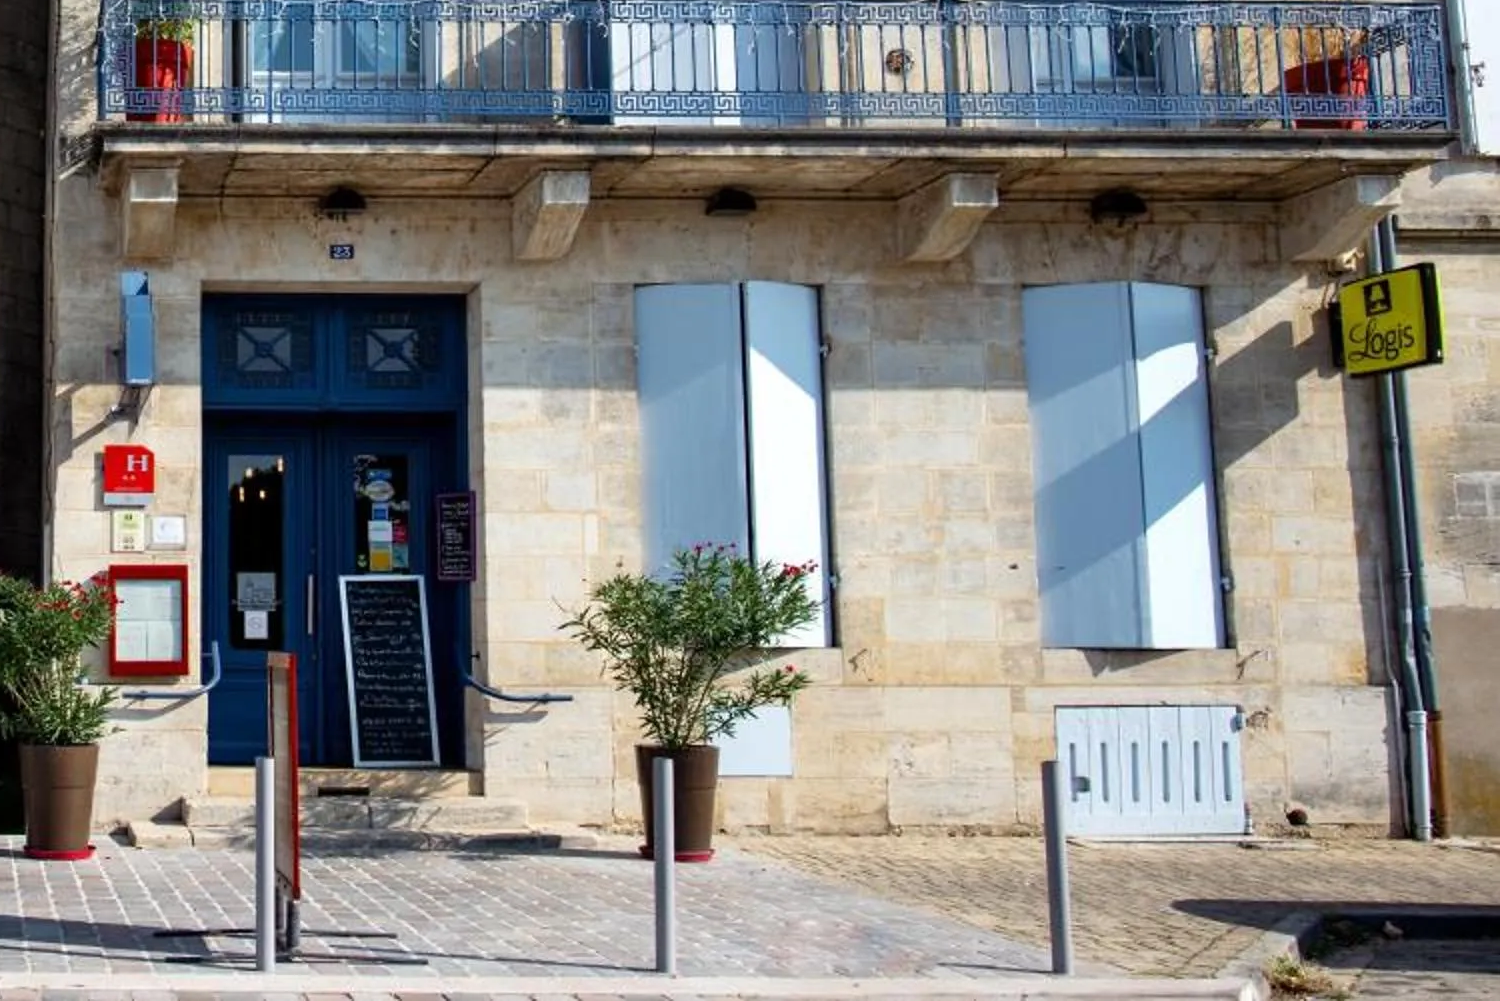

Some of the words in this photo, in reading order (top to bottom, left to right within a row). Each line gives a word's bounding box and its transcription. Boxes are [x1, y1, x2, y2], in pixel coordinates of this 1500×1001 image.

[333, 246, 351, 259] 23
[1348, 318, 1415, 363] Logis
[127, 454, 149, 472] H
